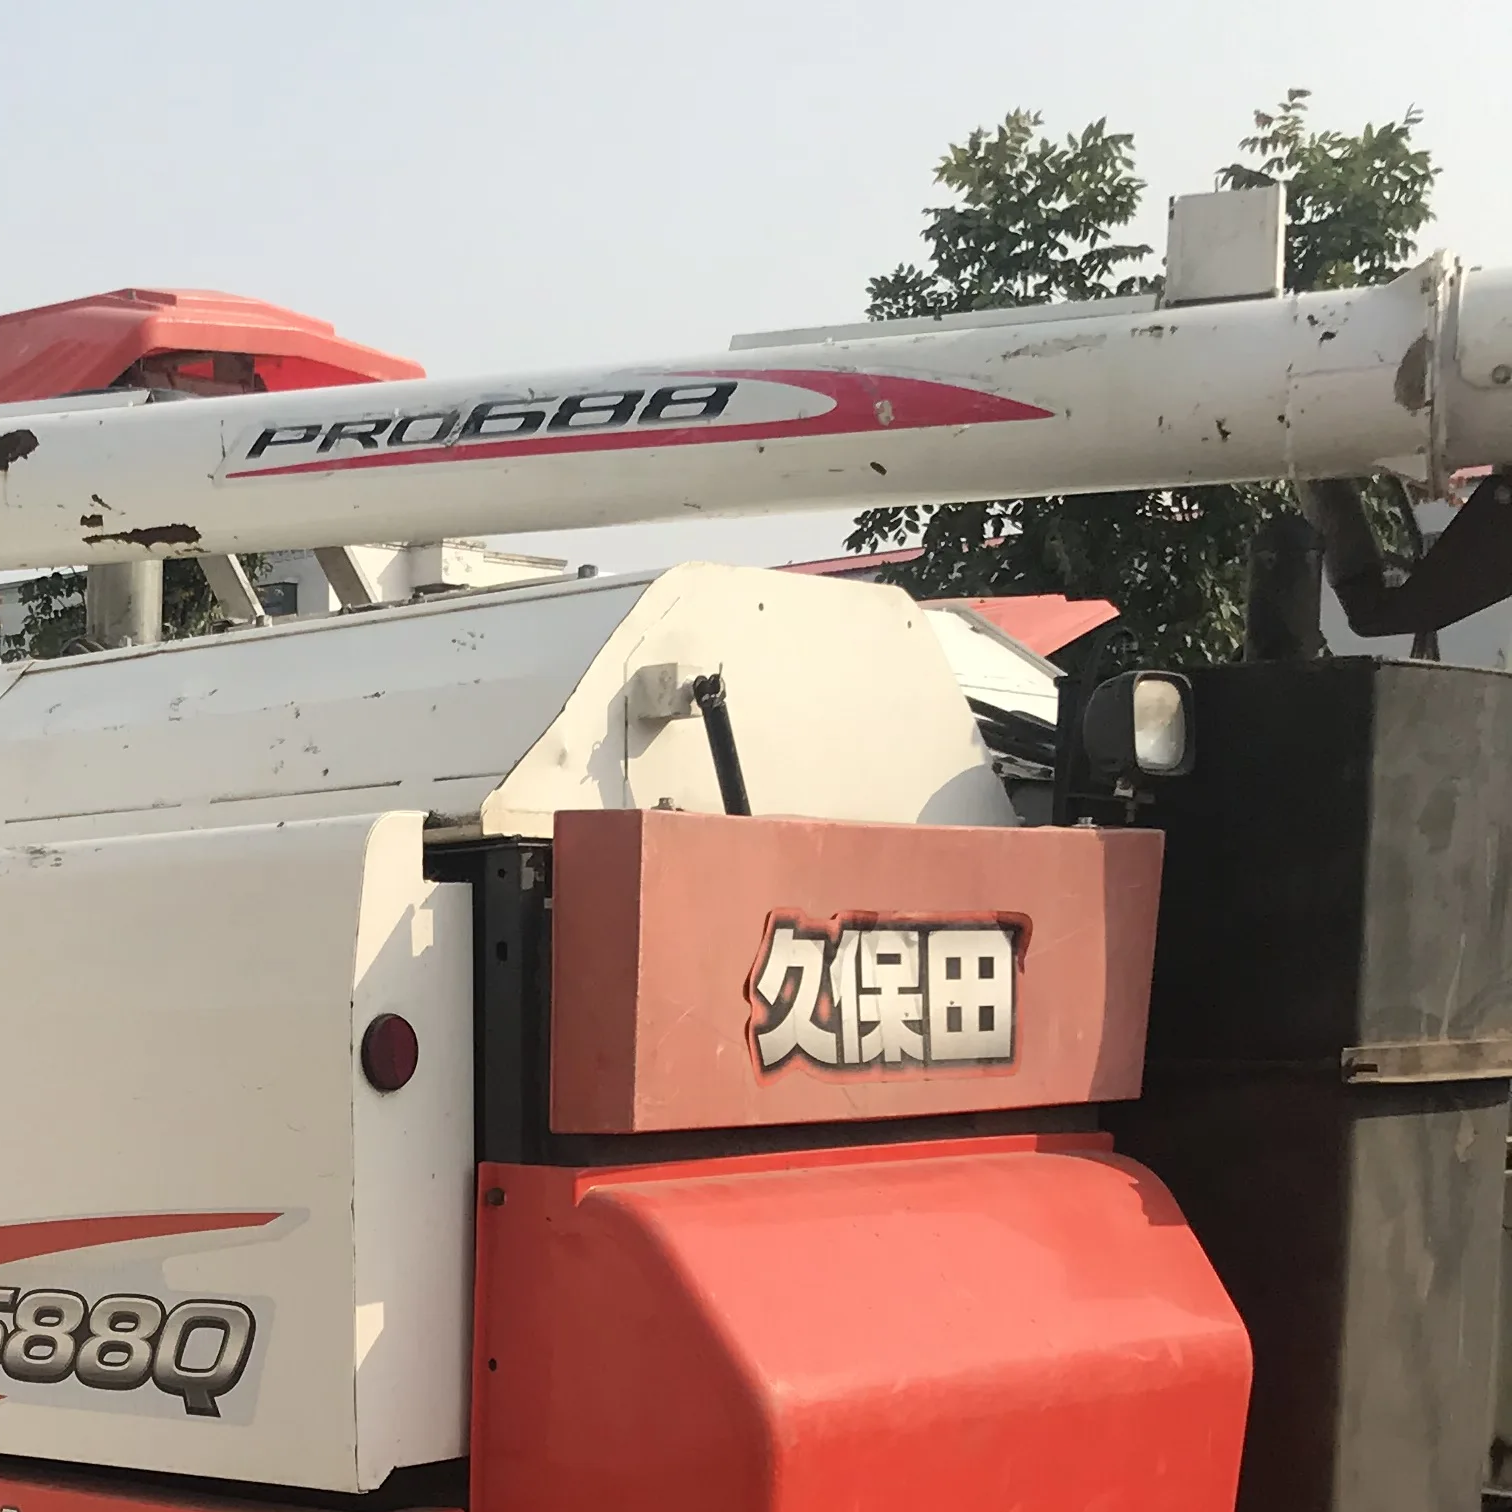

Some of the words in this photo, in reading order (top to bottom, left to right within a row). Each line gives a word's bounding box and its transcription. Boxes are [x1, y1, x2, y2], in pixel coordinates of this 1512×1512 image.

[245, 381, 738, 459] PRO688
[756, 927, 1013, 1067] 久保田
